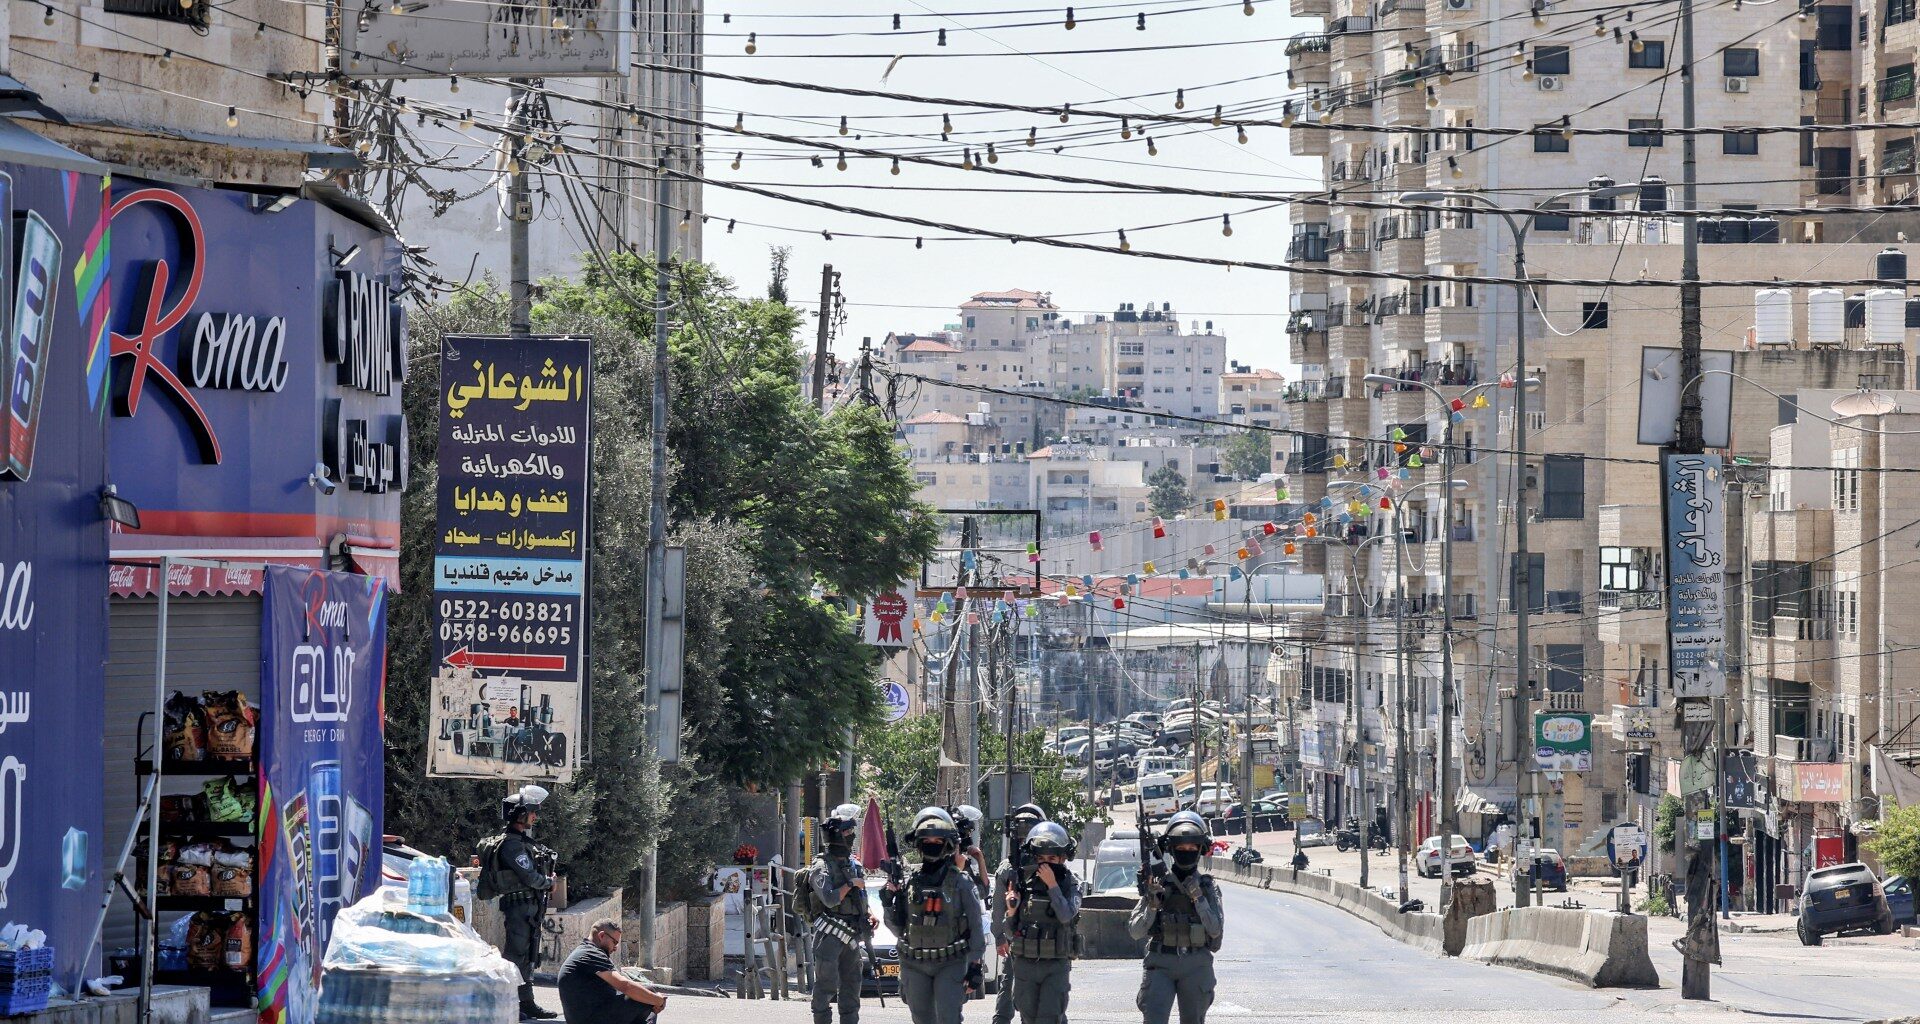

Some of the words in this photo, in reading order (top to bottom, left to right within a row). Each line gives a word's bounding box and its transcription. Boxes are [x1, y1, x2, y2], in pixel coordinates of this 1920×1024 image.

[111, 187, 289, 466] Roma
[351, 272, 393, 397] ROMA
[447, 357, 582, 419] الشوعاني
[452, 423, 505, 444] المنزلية
[461, 453, 565, 480] والكهربائية
[526, 488, 569, 513] تحف
[444, 527, 480, 545] سجاد
[444, 564, 490, 585] قلنديا
[493, 566, 529, 586] مخيم
[533, 566, 573, 586] مدخل
[302, 570, 346, 647] Roma
[440, 599, 572, 622] 0522-603821
[440, 622, 571, 645] 0598-966695
